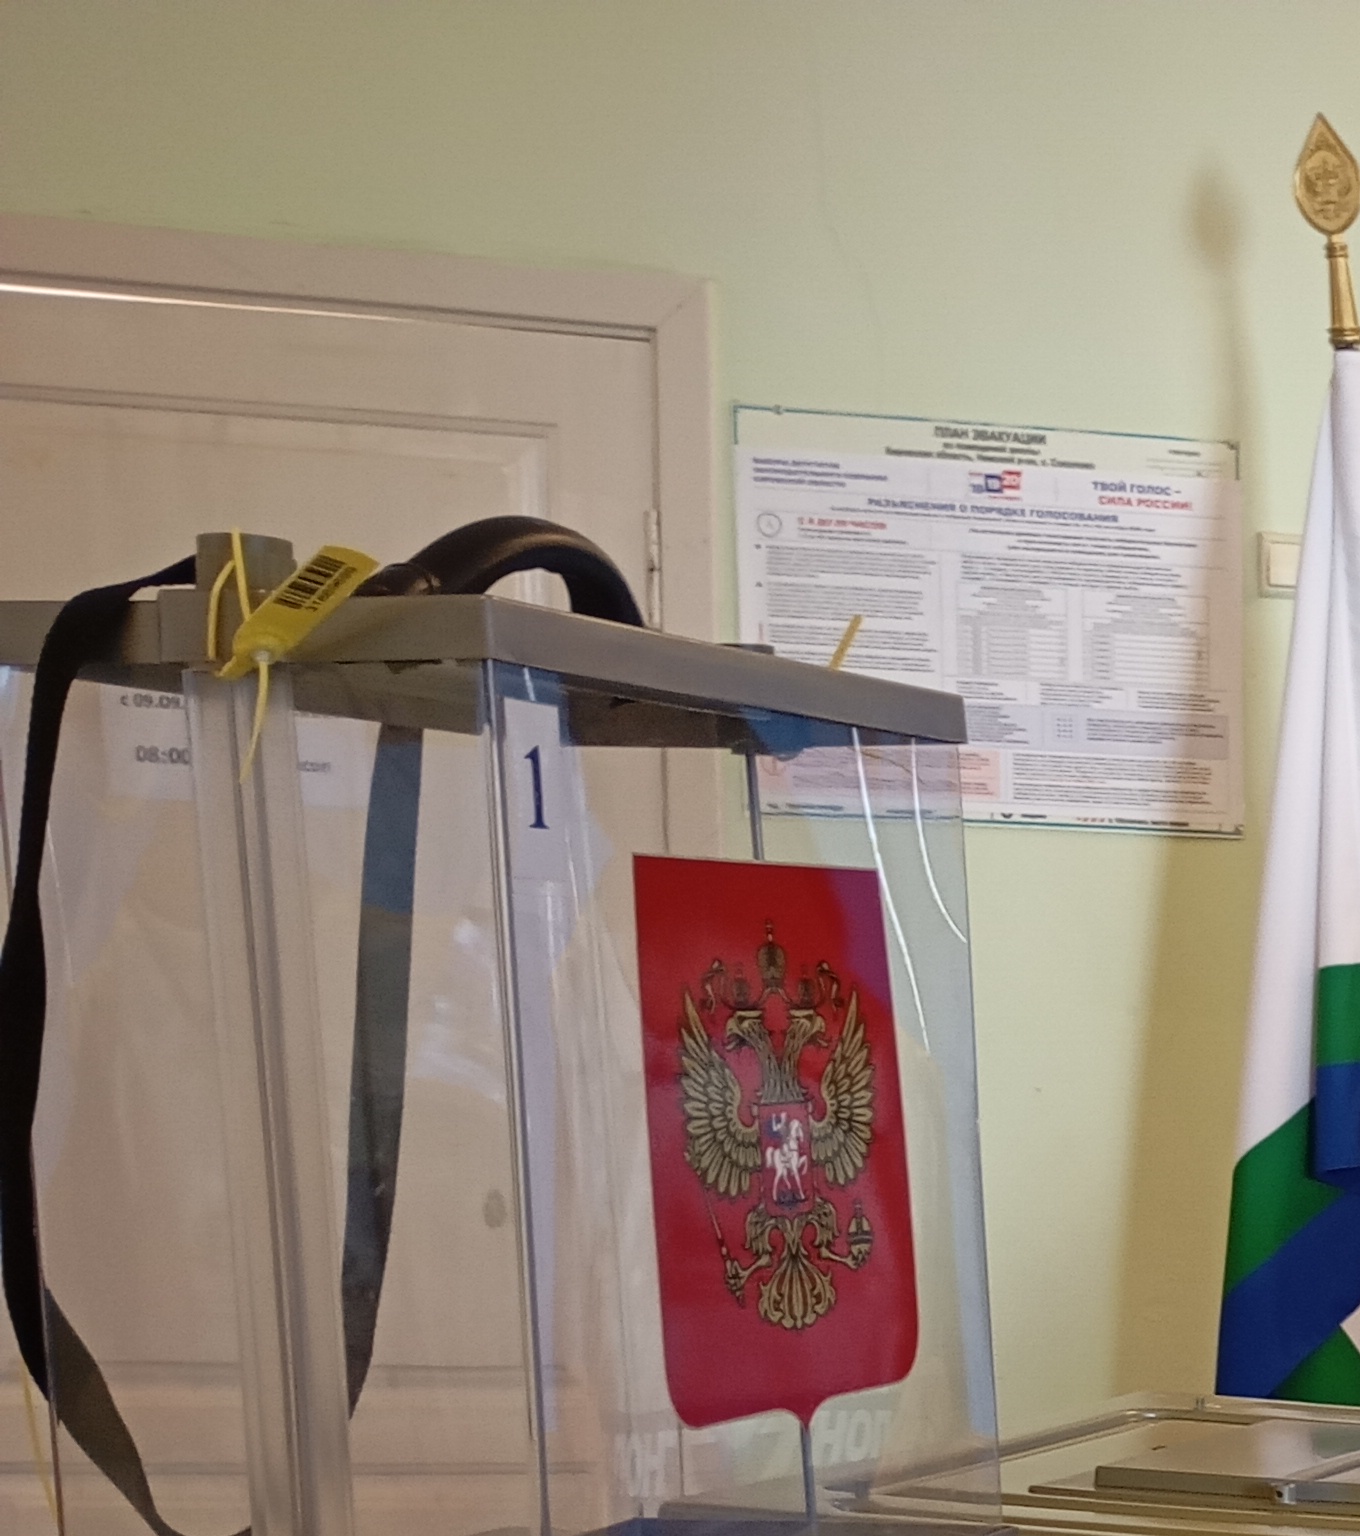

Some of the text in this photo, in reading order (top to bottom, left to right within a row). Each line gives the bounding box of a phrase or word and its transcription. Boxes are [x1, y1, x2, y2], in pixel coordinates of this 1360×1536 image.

[1091, 480, 1127, 493] ТВОЙ
[1129, 483, 1172, 496] ГОЛОС
[1098, 495, 1133, 507] СИЛА
[523, 744, 551, 830] 1
